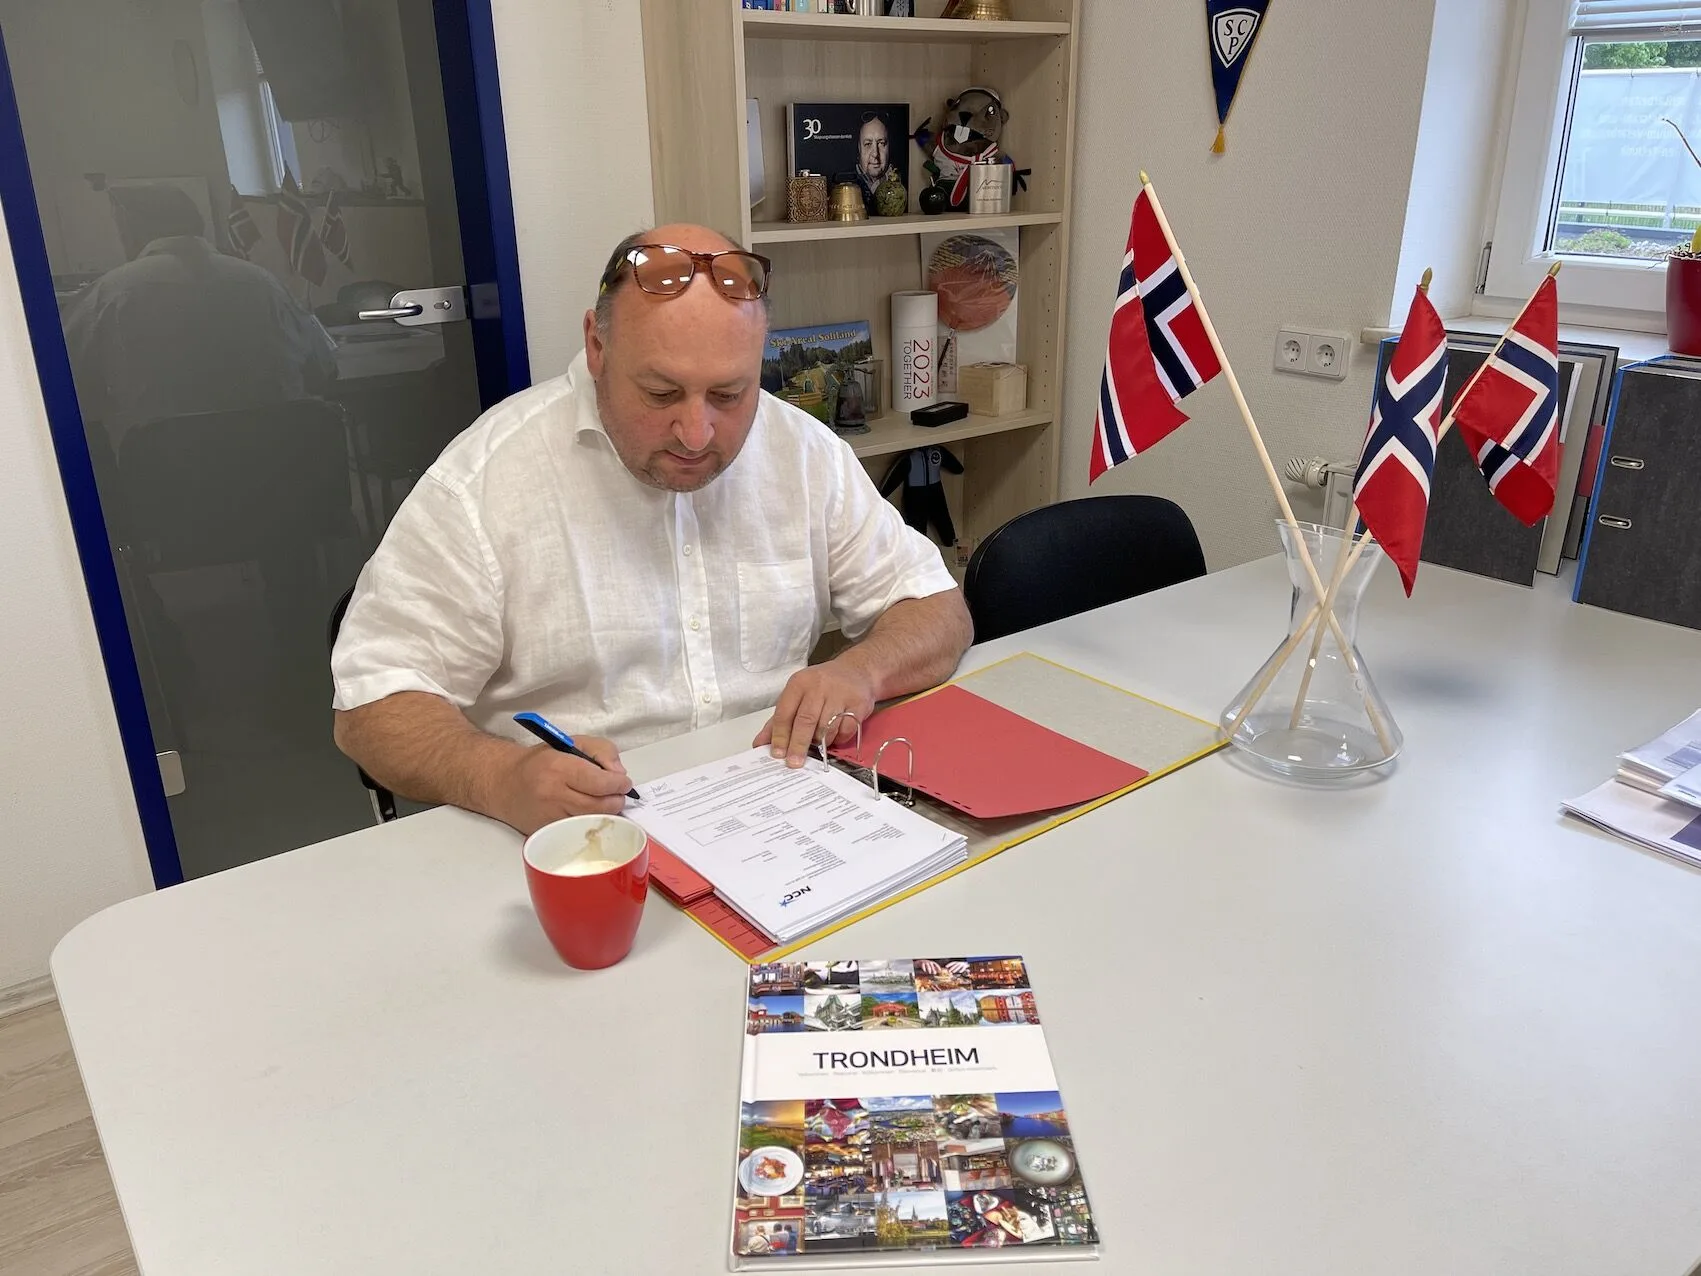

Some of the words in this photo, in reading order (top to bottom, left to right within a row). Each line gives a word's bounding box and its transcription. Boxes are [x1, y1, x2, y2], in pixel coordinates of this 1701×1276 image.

[803, 119, 821, 140] 30
[903, 339, 912, 400] TOGETHER
[913, 339, 930, 399] 2023
[784, 885, 811, 902] NCC
[812, 1047, 980, 1070] TRONDHEIM
